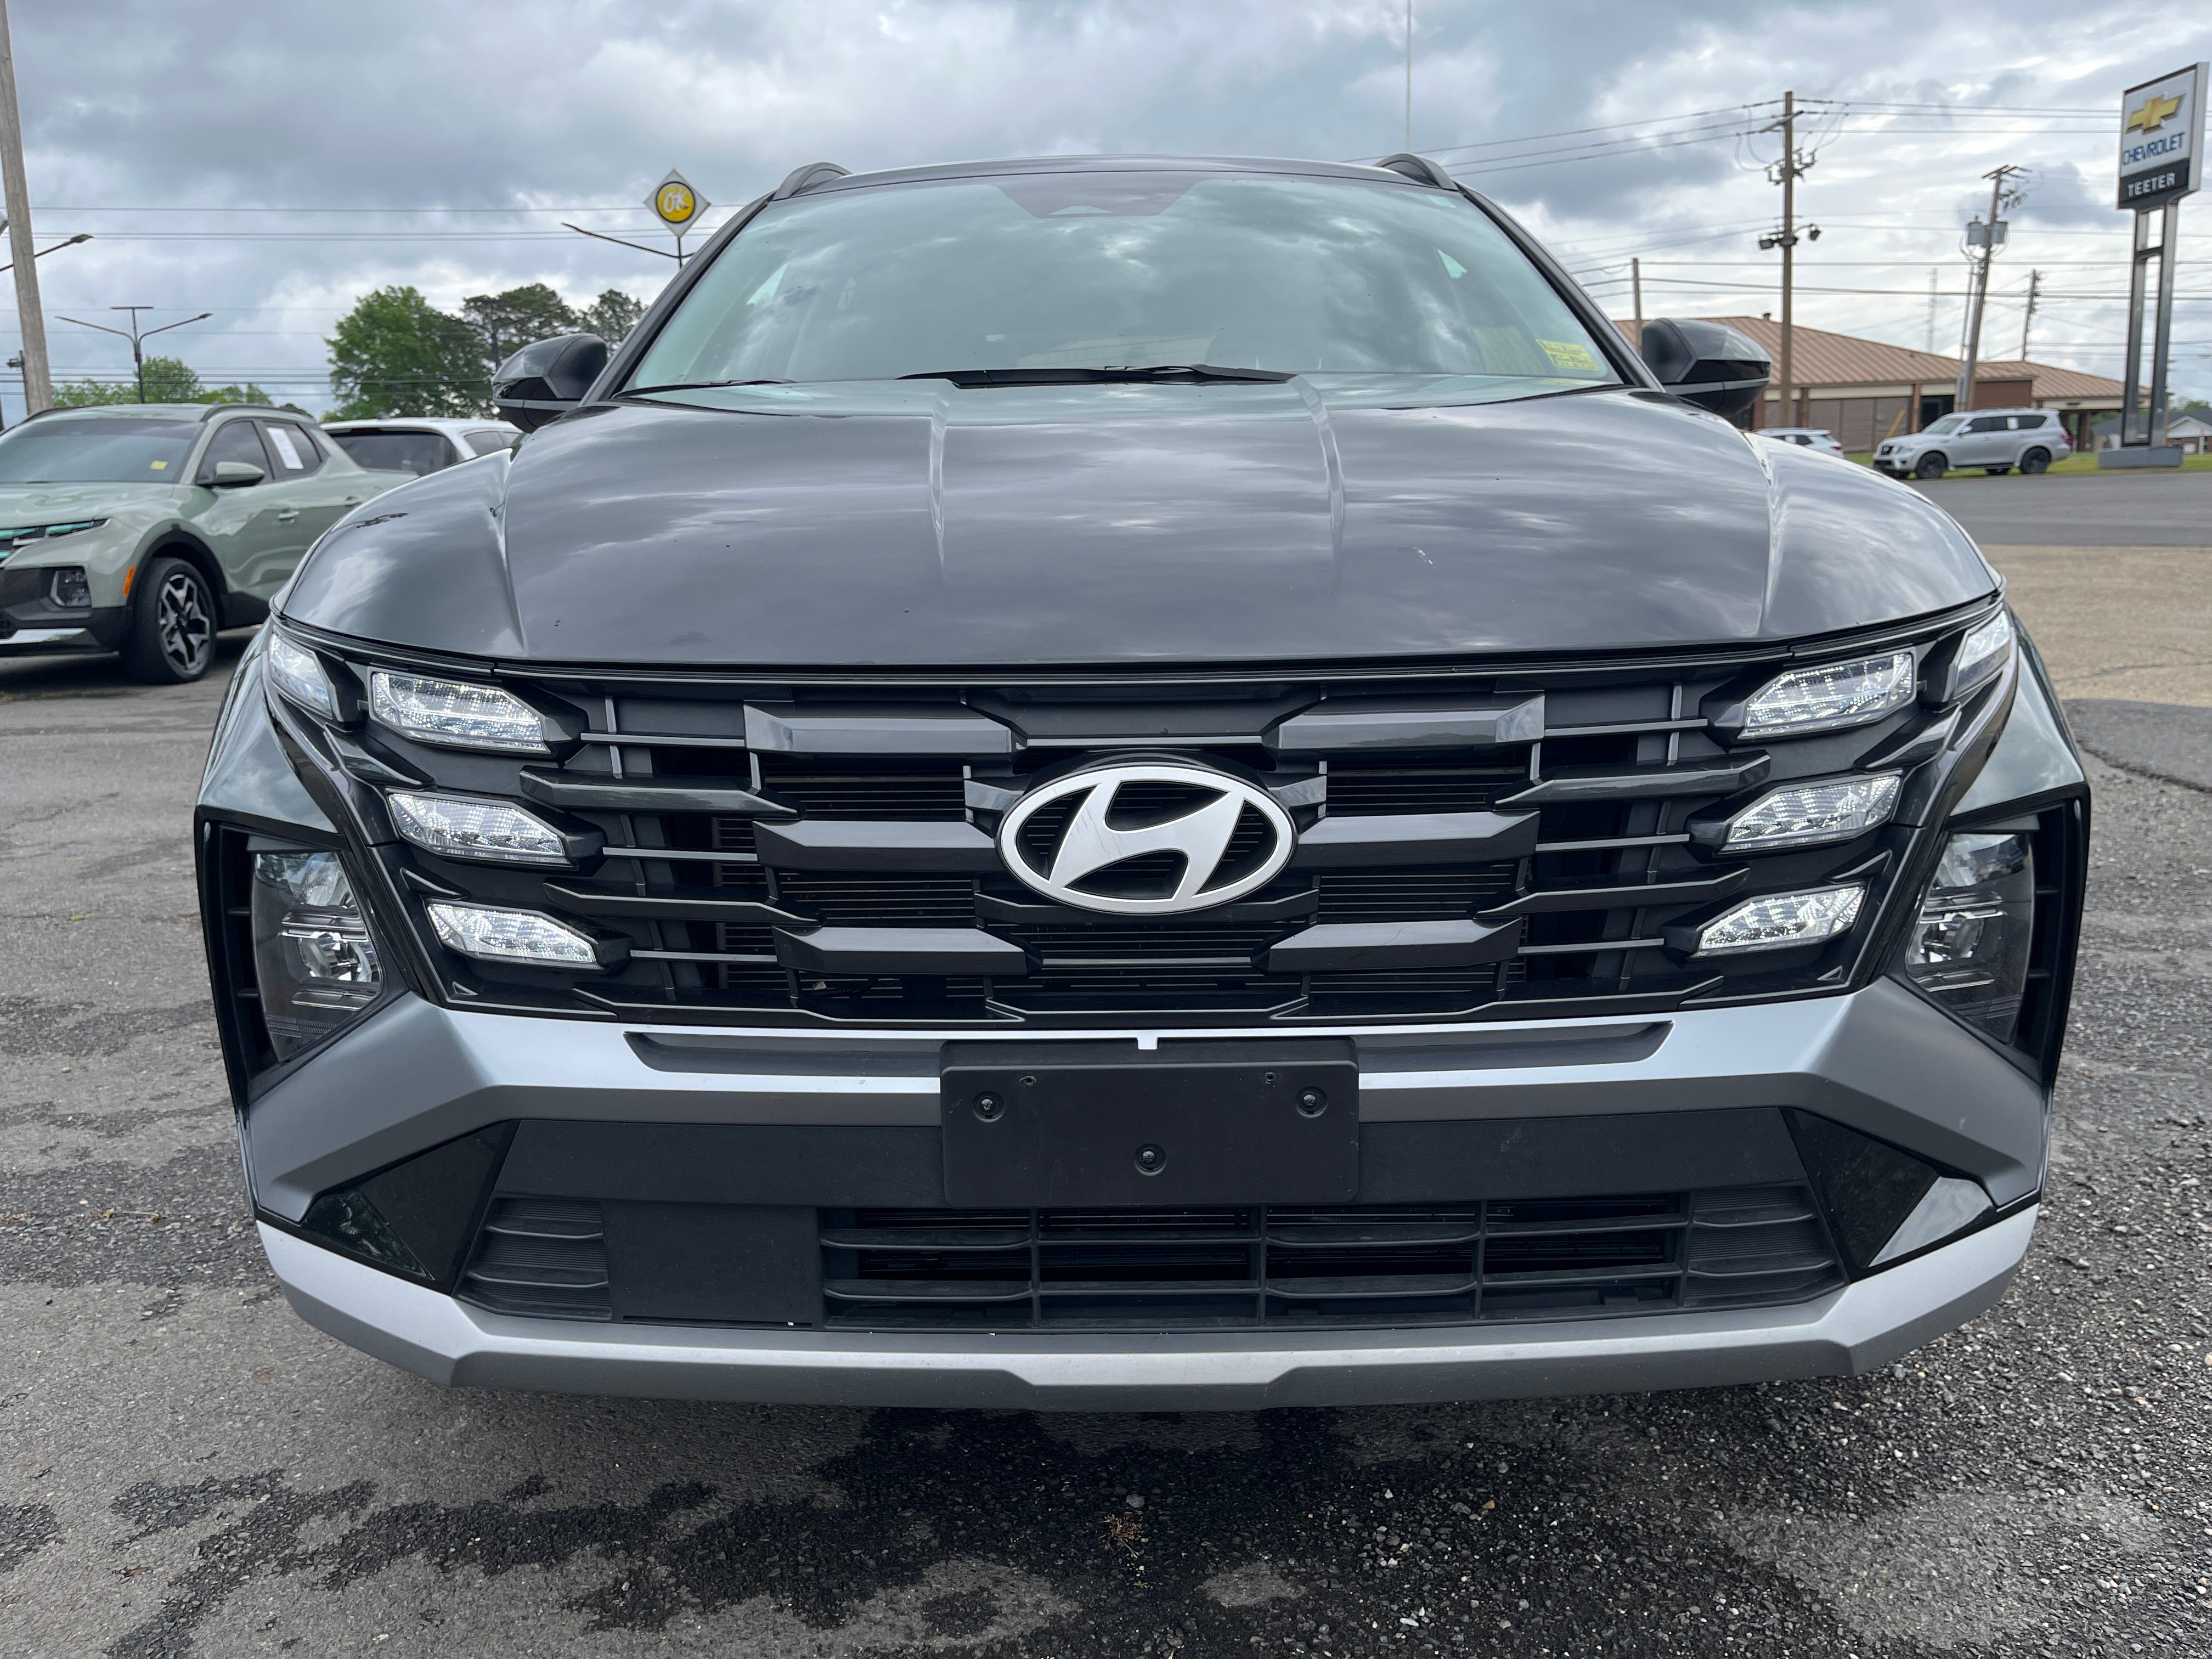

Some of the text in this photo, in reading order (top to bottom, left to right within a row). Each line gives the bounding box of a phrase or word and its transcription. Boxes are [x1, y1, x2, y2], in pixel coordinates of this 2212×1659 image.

[2123, 132, 2186, 166] CHEVROLET
[2127, 172, 2176, 198] TEETER
[662, 188, 690, 214] OK
